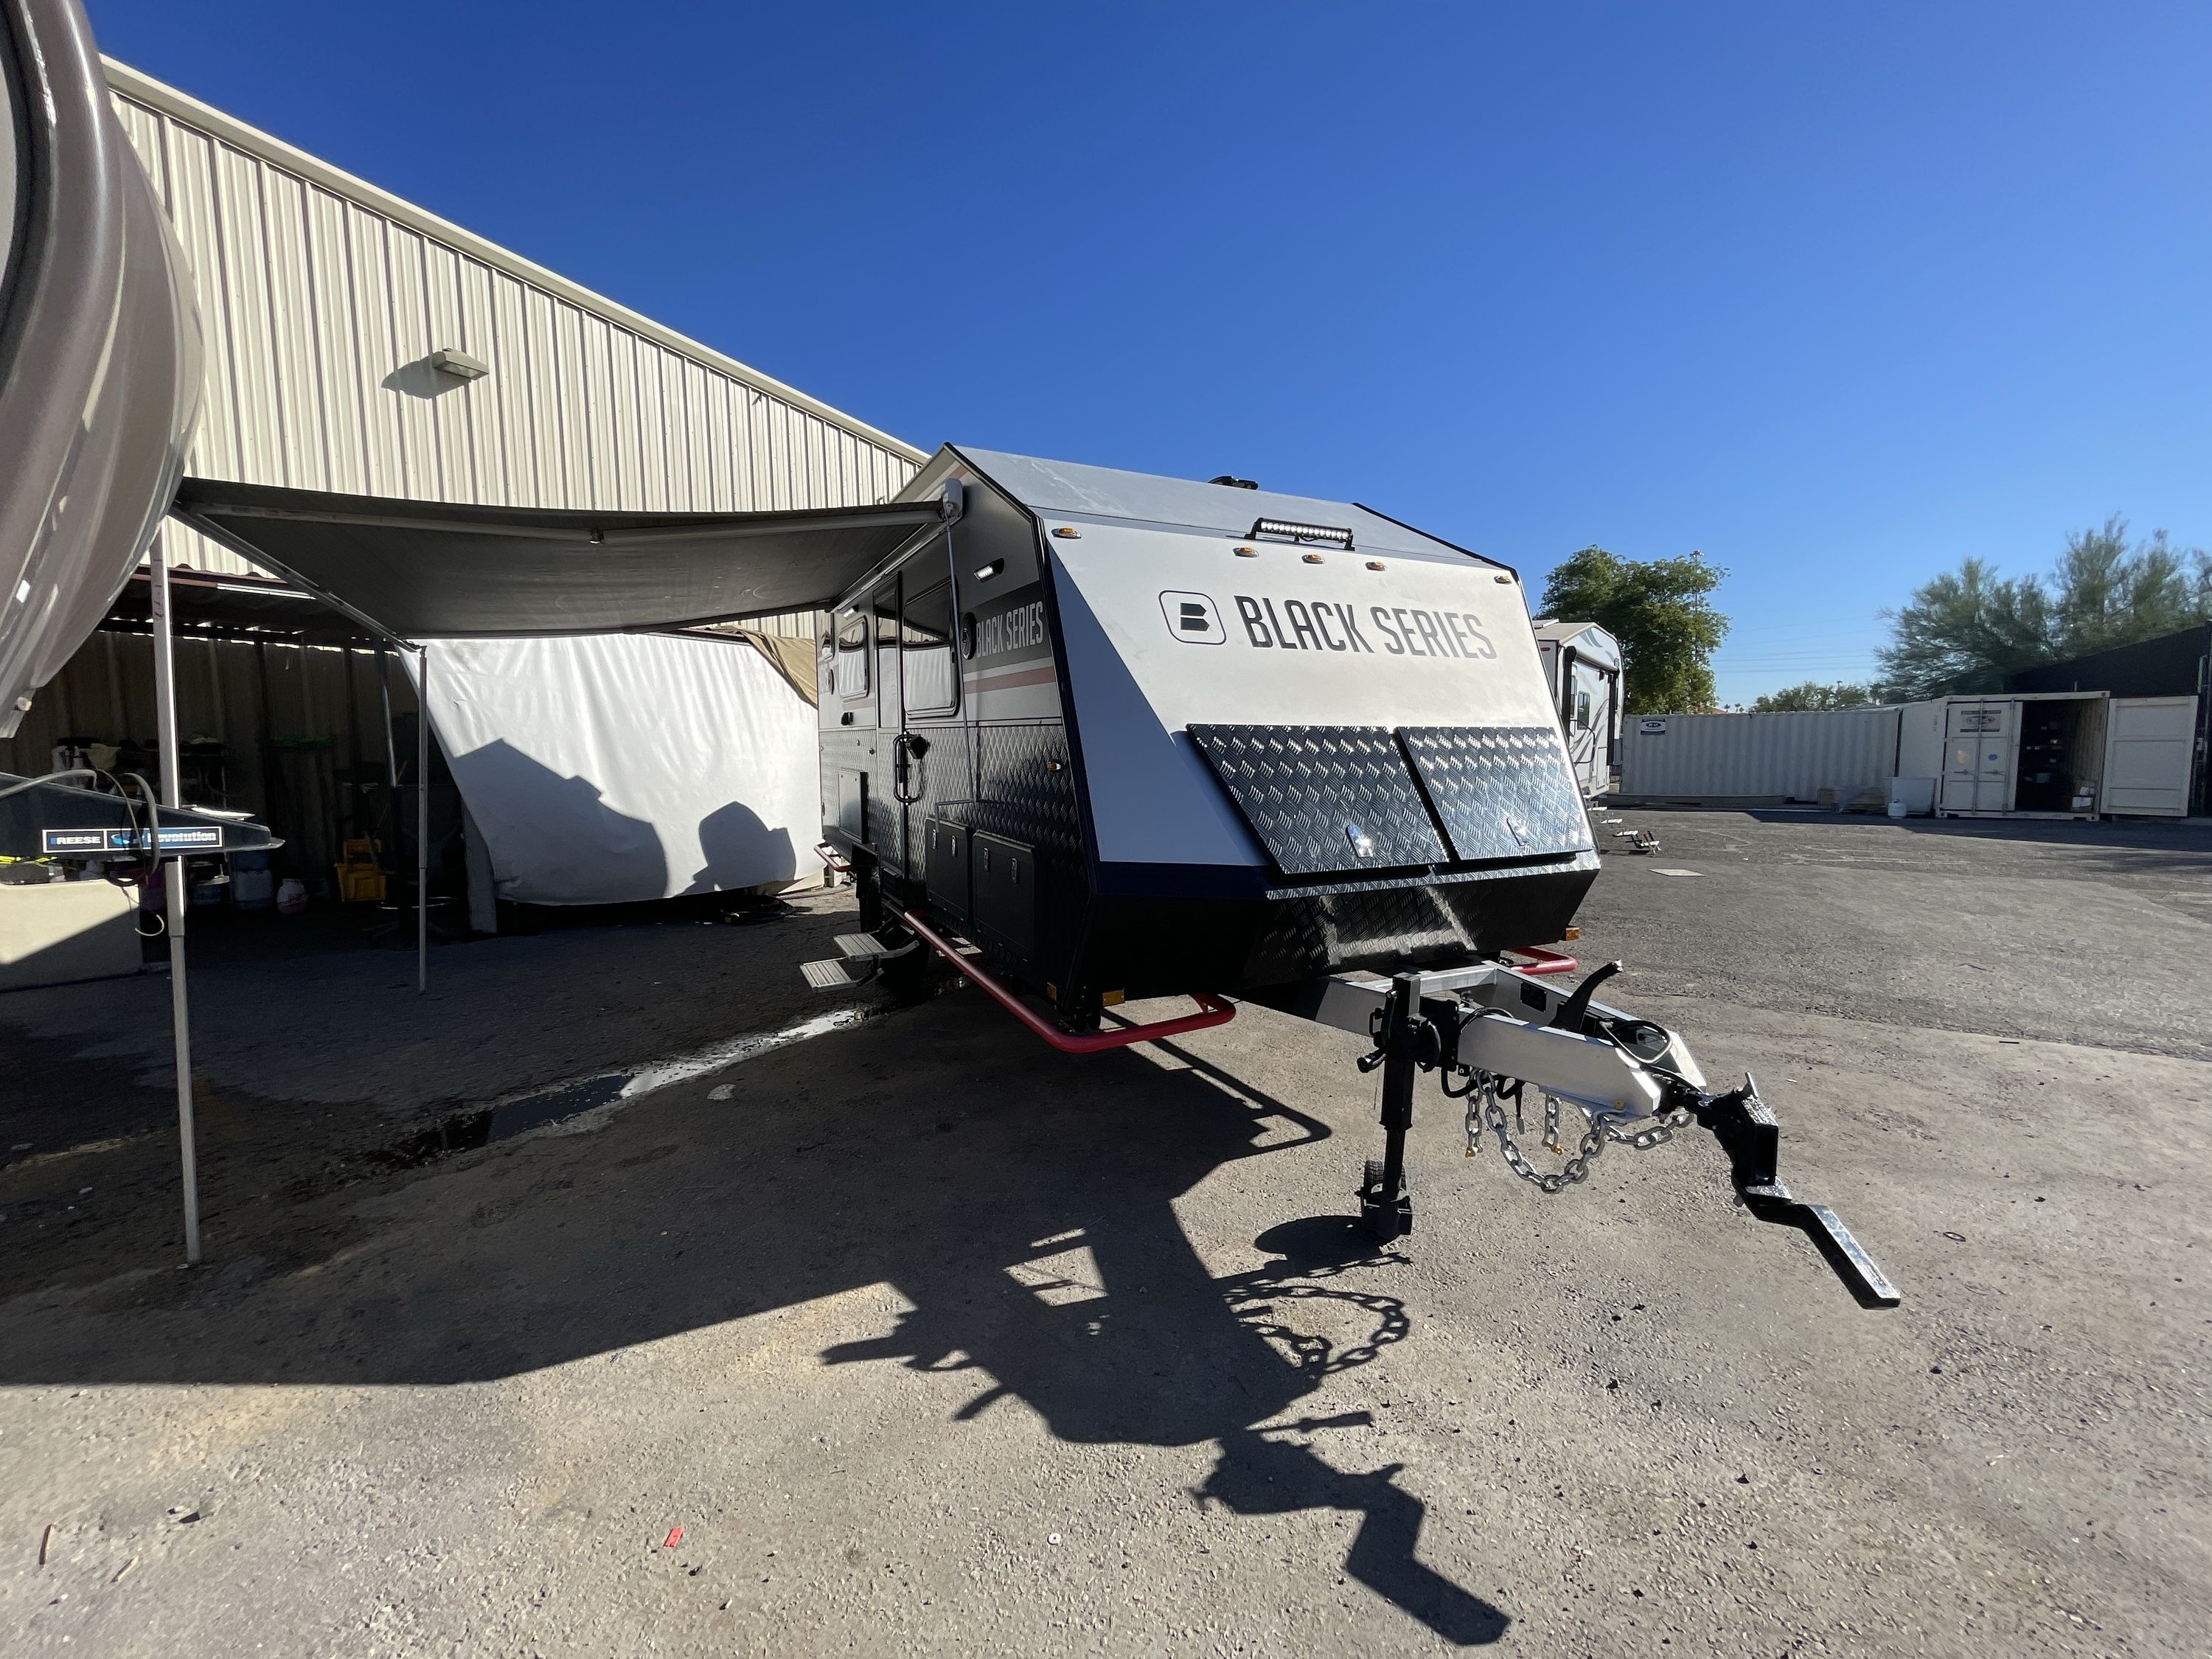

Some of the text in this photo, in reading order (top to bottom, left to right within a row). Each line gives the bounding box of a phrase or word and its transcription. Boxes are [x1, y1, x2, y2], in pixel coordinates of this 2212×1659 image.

[975, 600, 1043, 658] BLACK SERIES
[1233, 595, 1498, 661] BLACK SERIES
[56, 835, 102, 845] REESE
